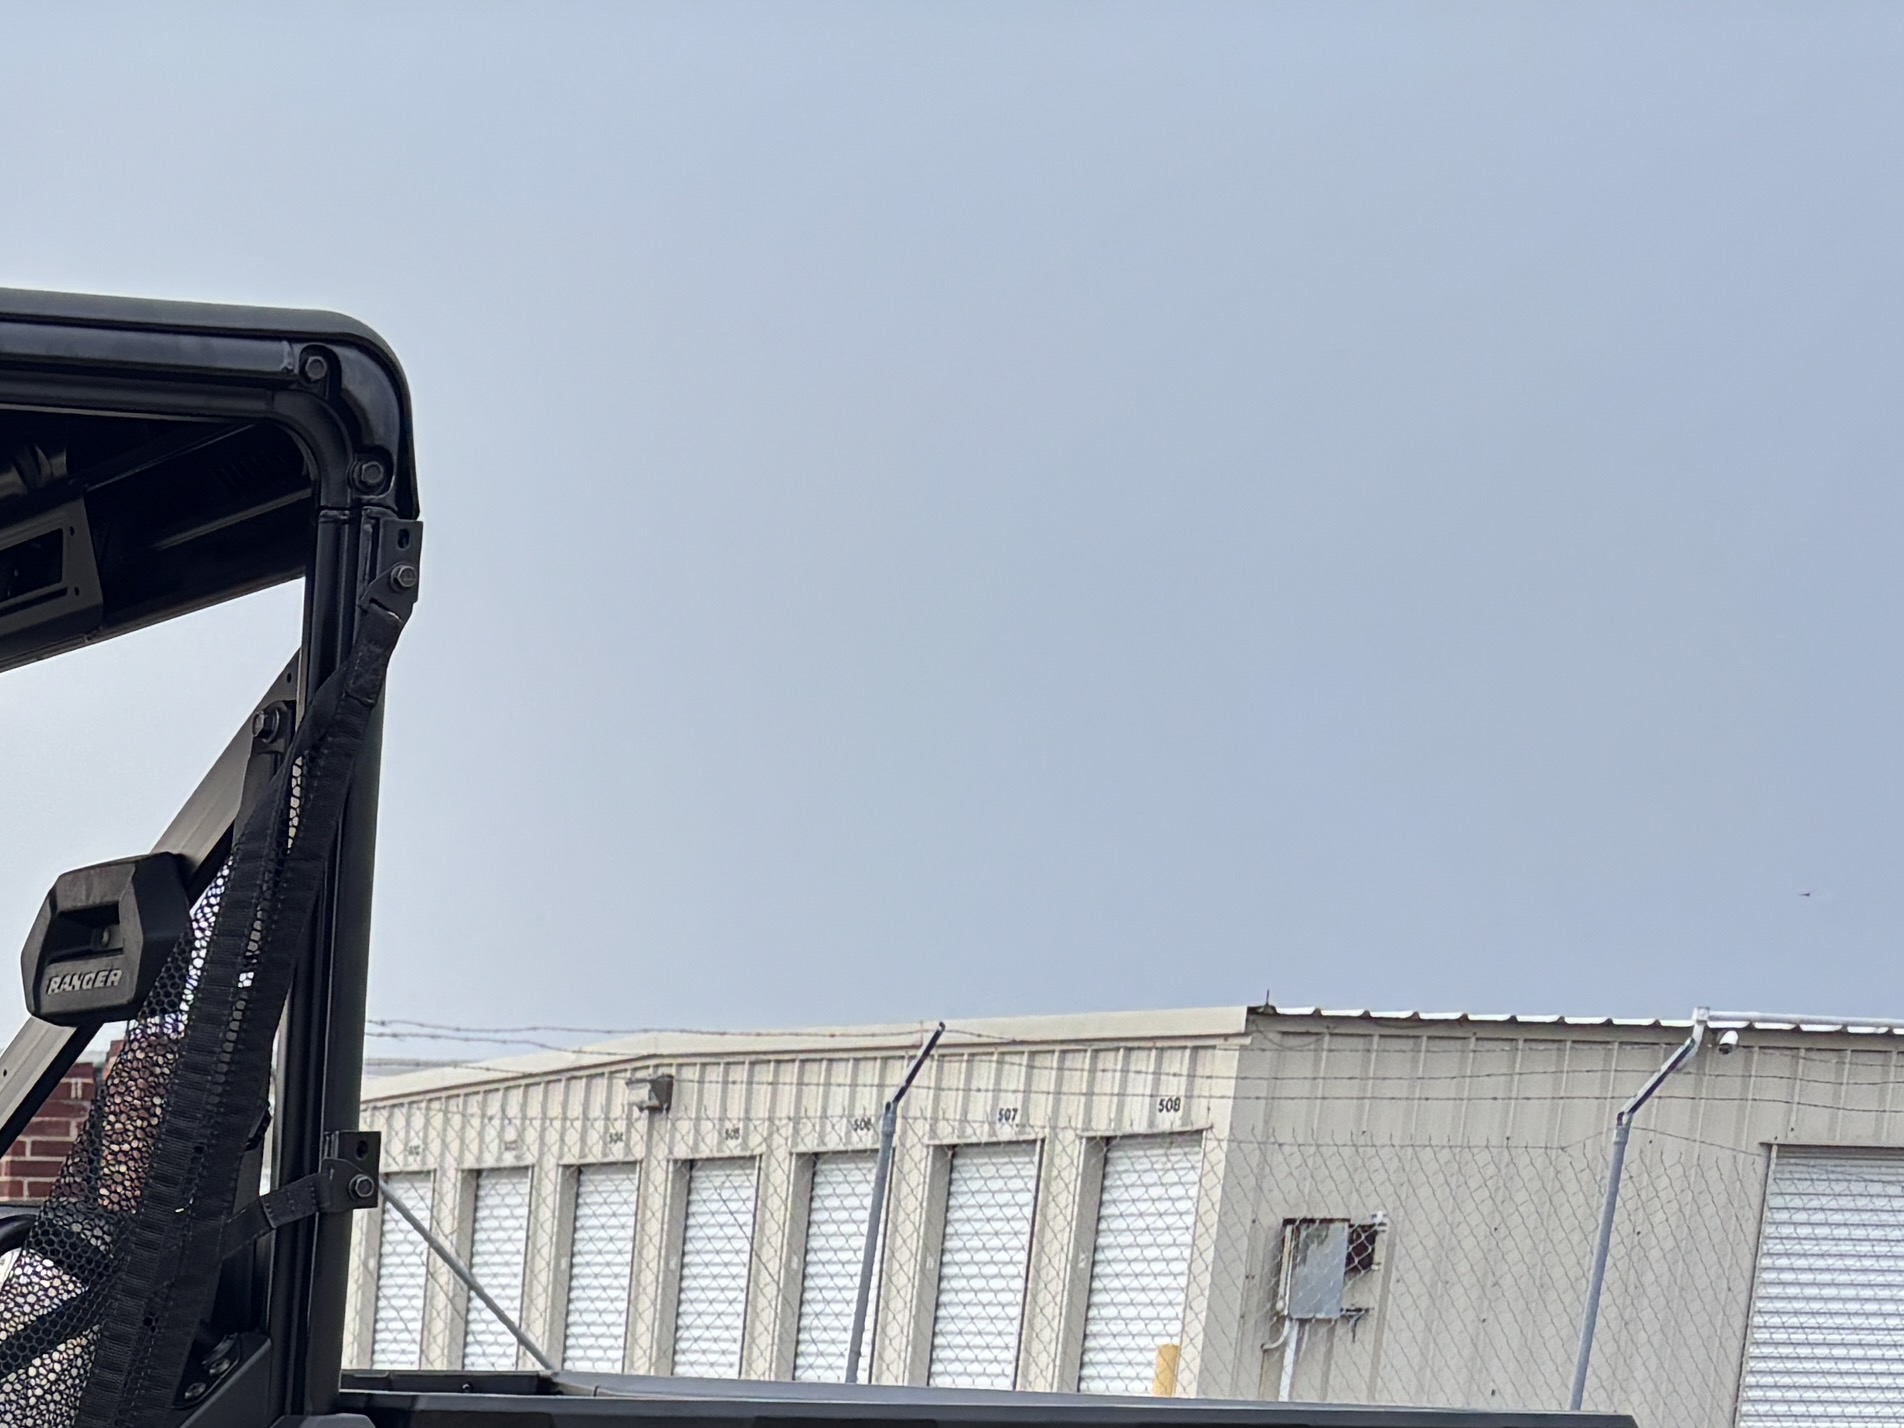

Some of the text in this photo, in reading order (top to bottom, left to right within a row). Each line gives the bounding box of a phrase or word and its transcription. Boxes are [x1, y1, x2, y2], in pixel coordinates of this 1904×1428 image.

[46, 967, 123, 996] RANGER
[1158, 1096, 1181, 1113] 508
[997, 1107, 1019, 1122] 507
